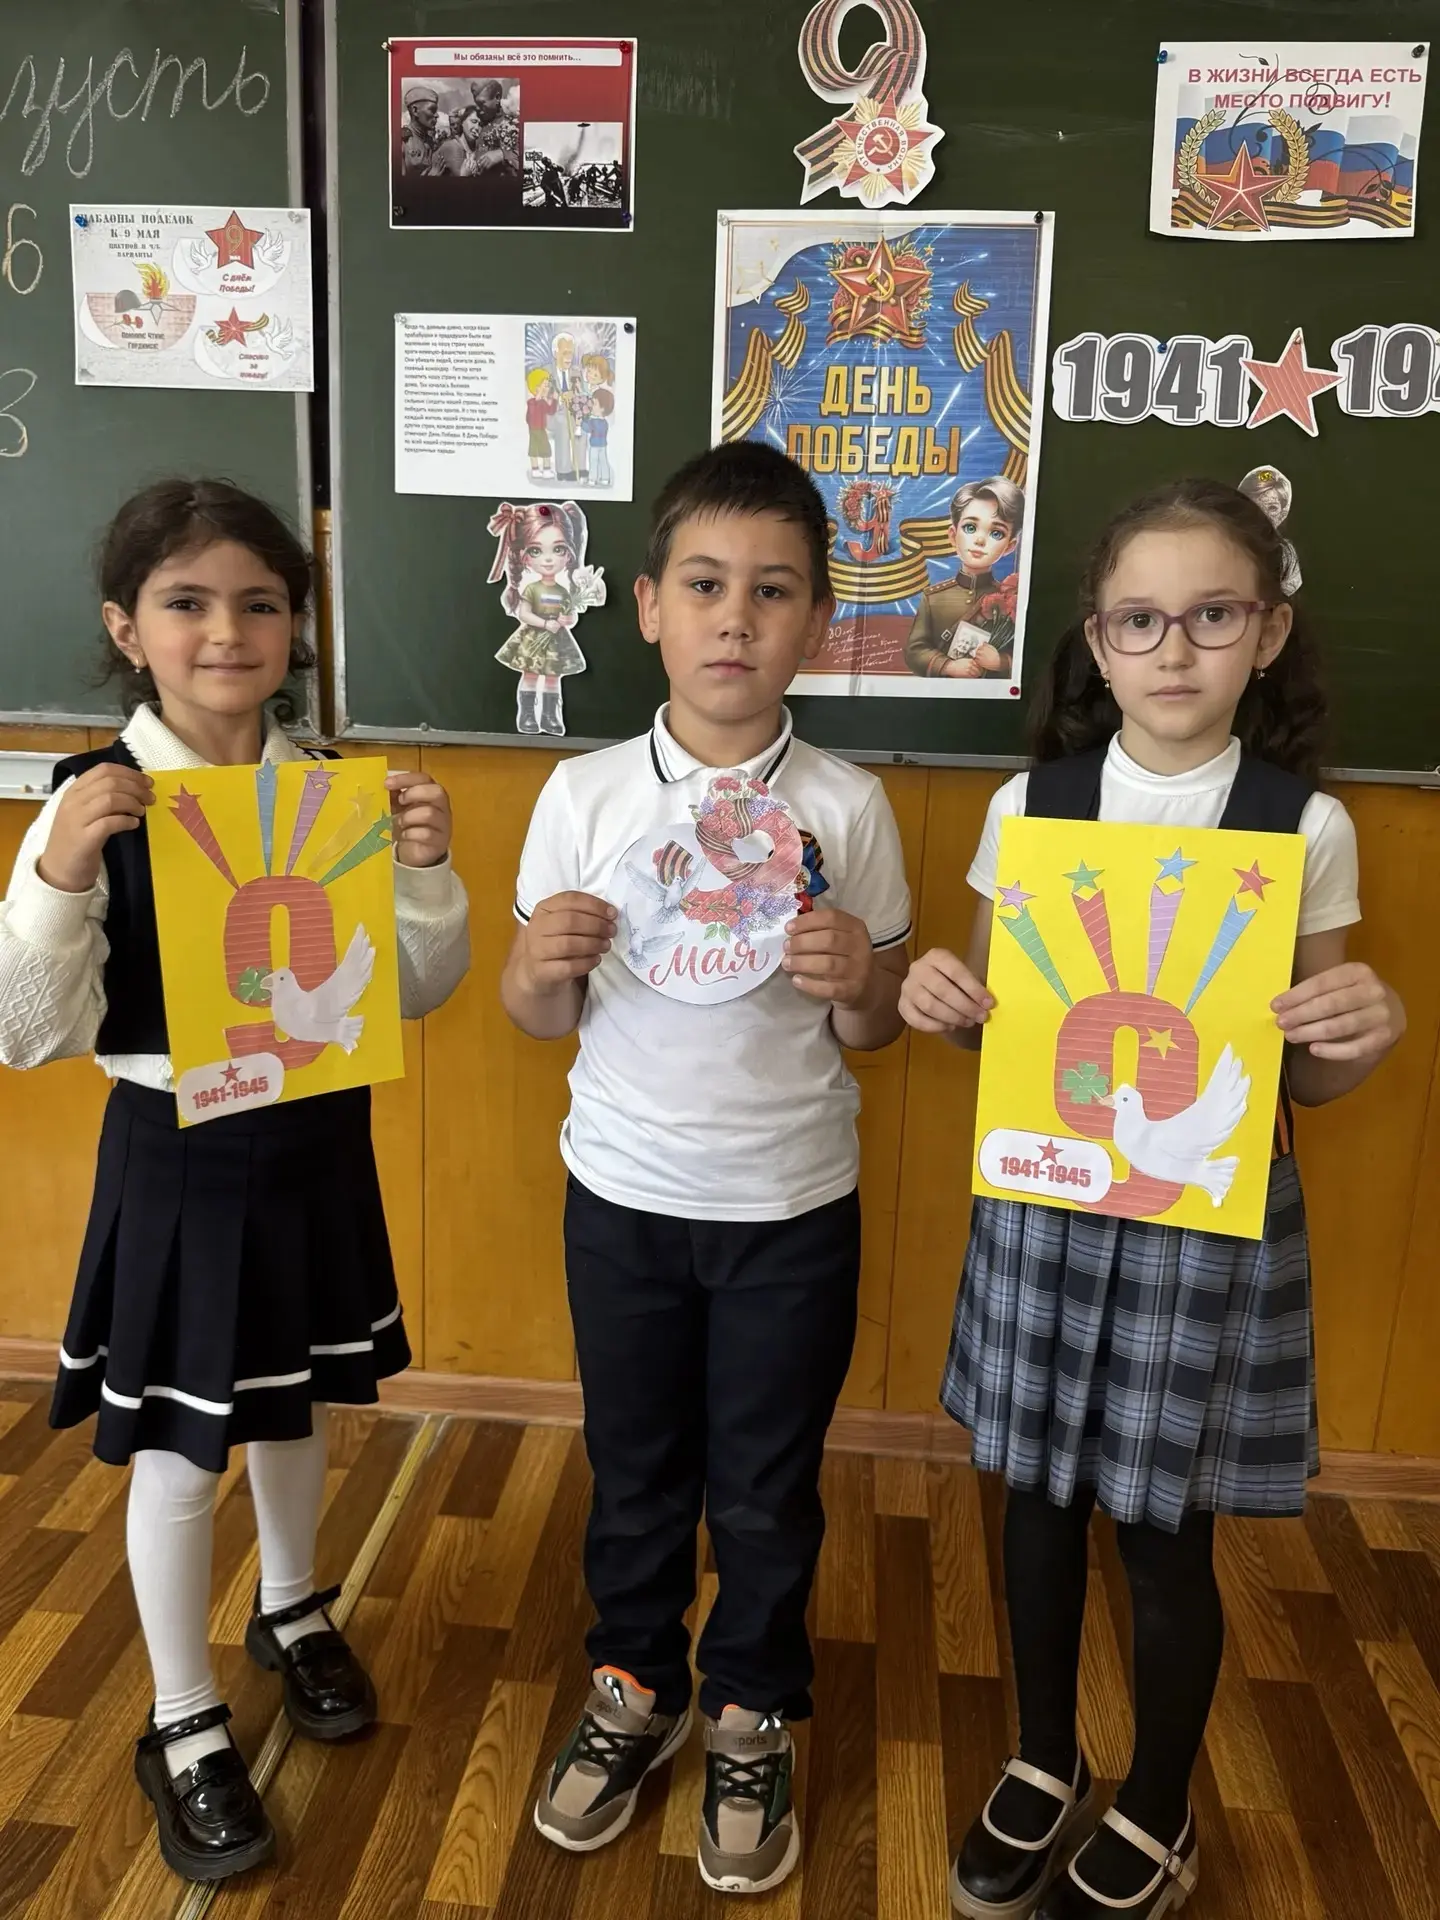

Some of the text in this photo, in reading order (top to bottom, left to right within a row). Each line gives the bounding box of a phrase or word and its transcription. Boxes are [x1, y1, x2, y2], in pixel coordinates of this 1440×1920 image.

[453, 52, 468, 61] Мы
[469, 52, 505, 62] обязаны
[506, 53, 521, 61] всё
[522, 53, 537, 61] это
[1188, 67, 1423, 85] В ЖИЗНИ ВСЕГДА ЕСТЬ
[1214, 91, 1391, 111] МЕСТО ПОДВИГУ!
[856, 118, 906, 168] ОТЕЧЕСТВЕННАЯ
[110, 228, 161, 239] К 9 МАЯ
[141, 213, 194, 225] ПОДЕЛОК
[818, 364, 933, 418] ДЕНЬ
[1060, 335, 1250, 424] 1941
[786, 424, 962, 479] ПОБЕДЫ
[648, 940, 771, 987] Мая
[191, 1075, 270, 1110] 1941-1945
[998, 1155, 1092, 1188] 1941-1945
